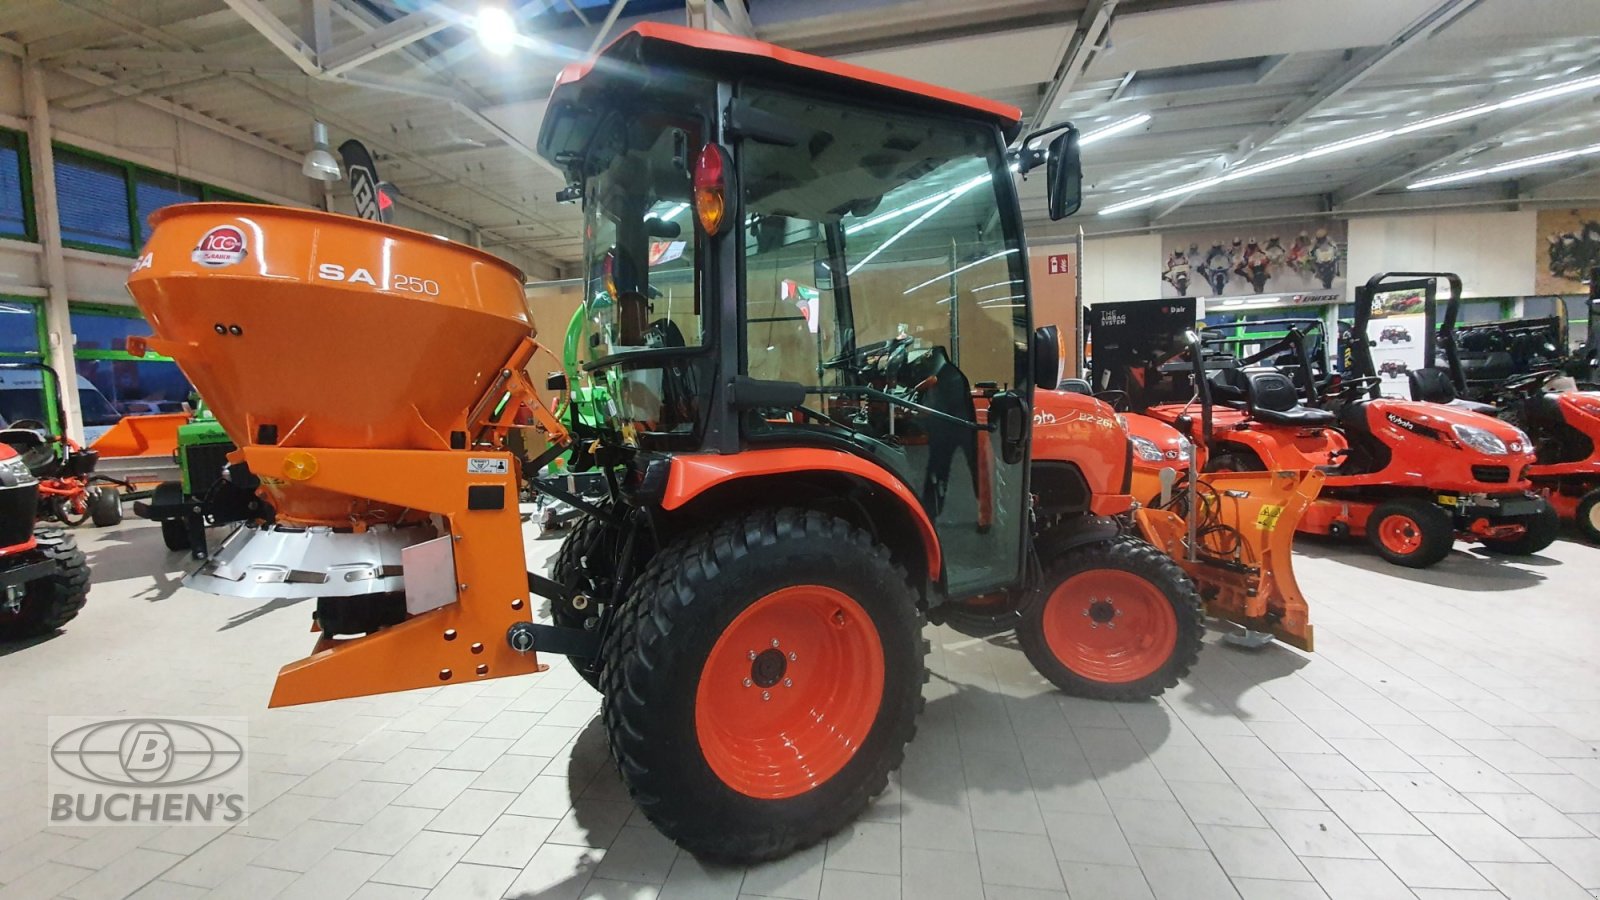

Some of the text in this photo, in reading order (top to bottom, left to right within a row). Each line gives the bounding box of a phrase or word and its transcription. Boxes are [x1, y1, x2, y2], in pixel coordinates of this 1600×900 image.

[207, 234, 239, 250] 100
[318, 263, 439, 296] SA 250
[1101, 309, 1117, 317] THE
[1101, 319, 1126, 327] SYSTEM
[1388, 413, 1414, 430] Kubota
